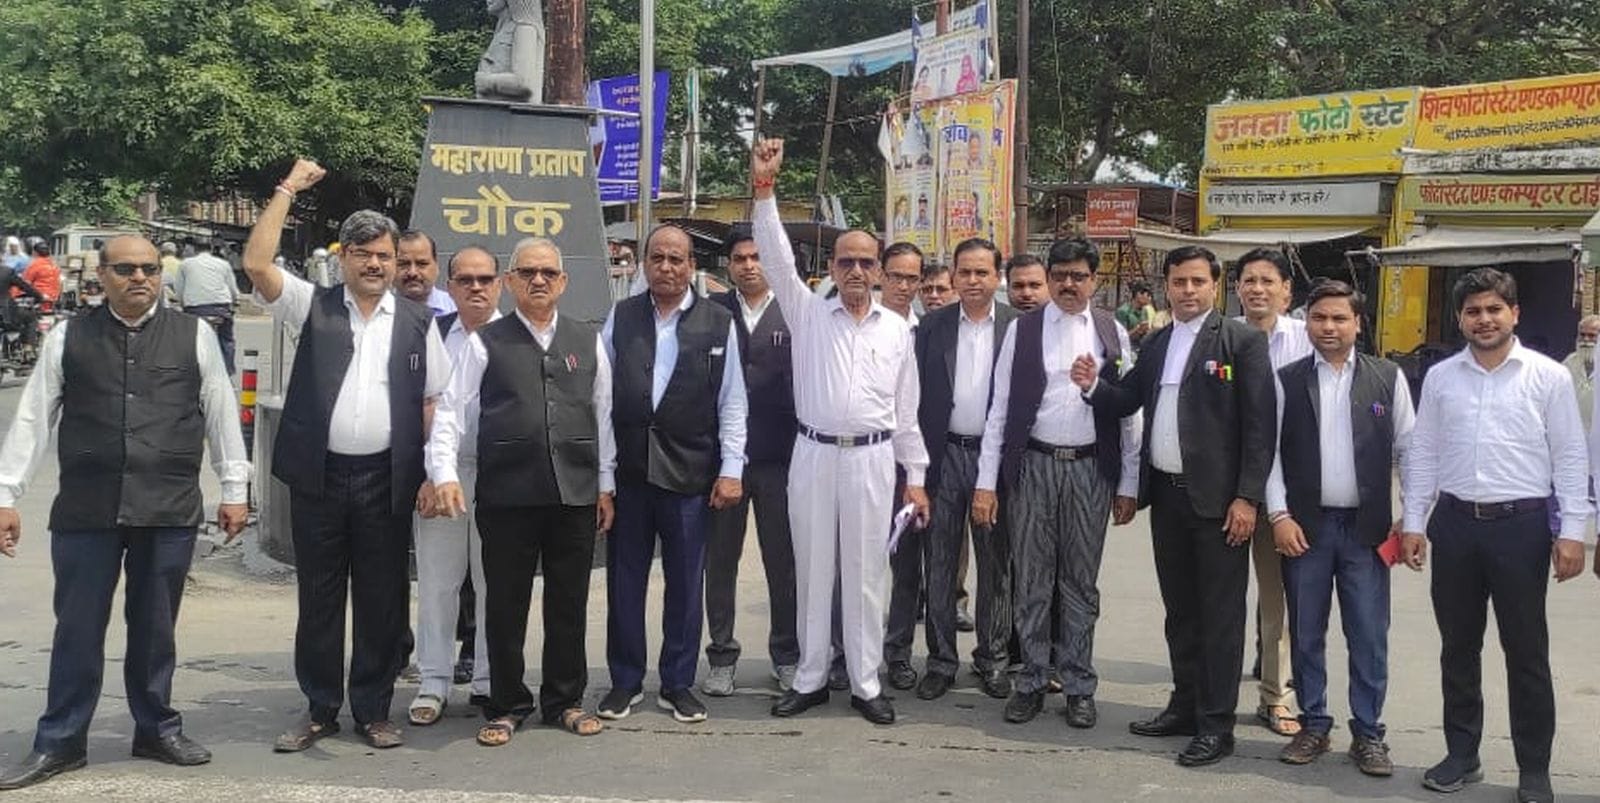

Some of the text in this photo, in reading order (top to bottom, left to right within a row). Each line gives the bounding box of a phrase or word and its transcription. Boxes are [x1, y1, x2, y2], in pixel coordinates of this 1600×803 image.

[1214, 111, 1292, 142] जनता
[1295, 98, 1350, 132] फोटो
[1358, 96, 1409, 126] स्टेट
[1419, 92, 1453, 122] शिव
[430, 144, 523, 175] महाराणा
[526, 149, 587, 177] प्रताप
[441, 185, 571, 236] चौक
